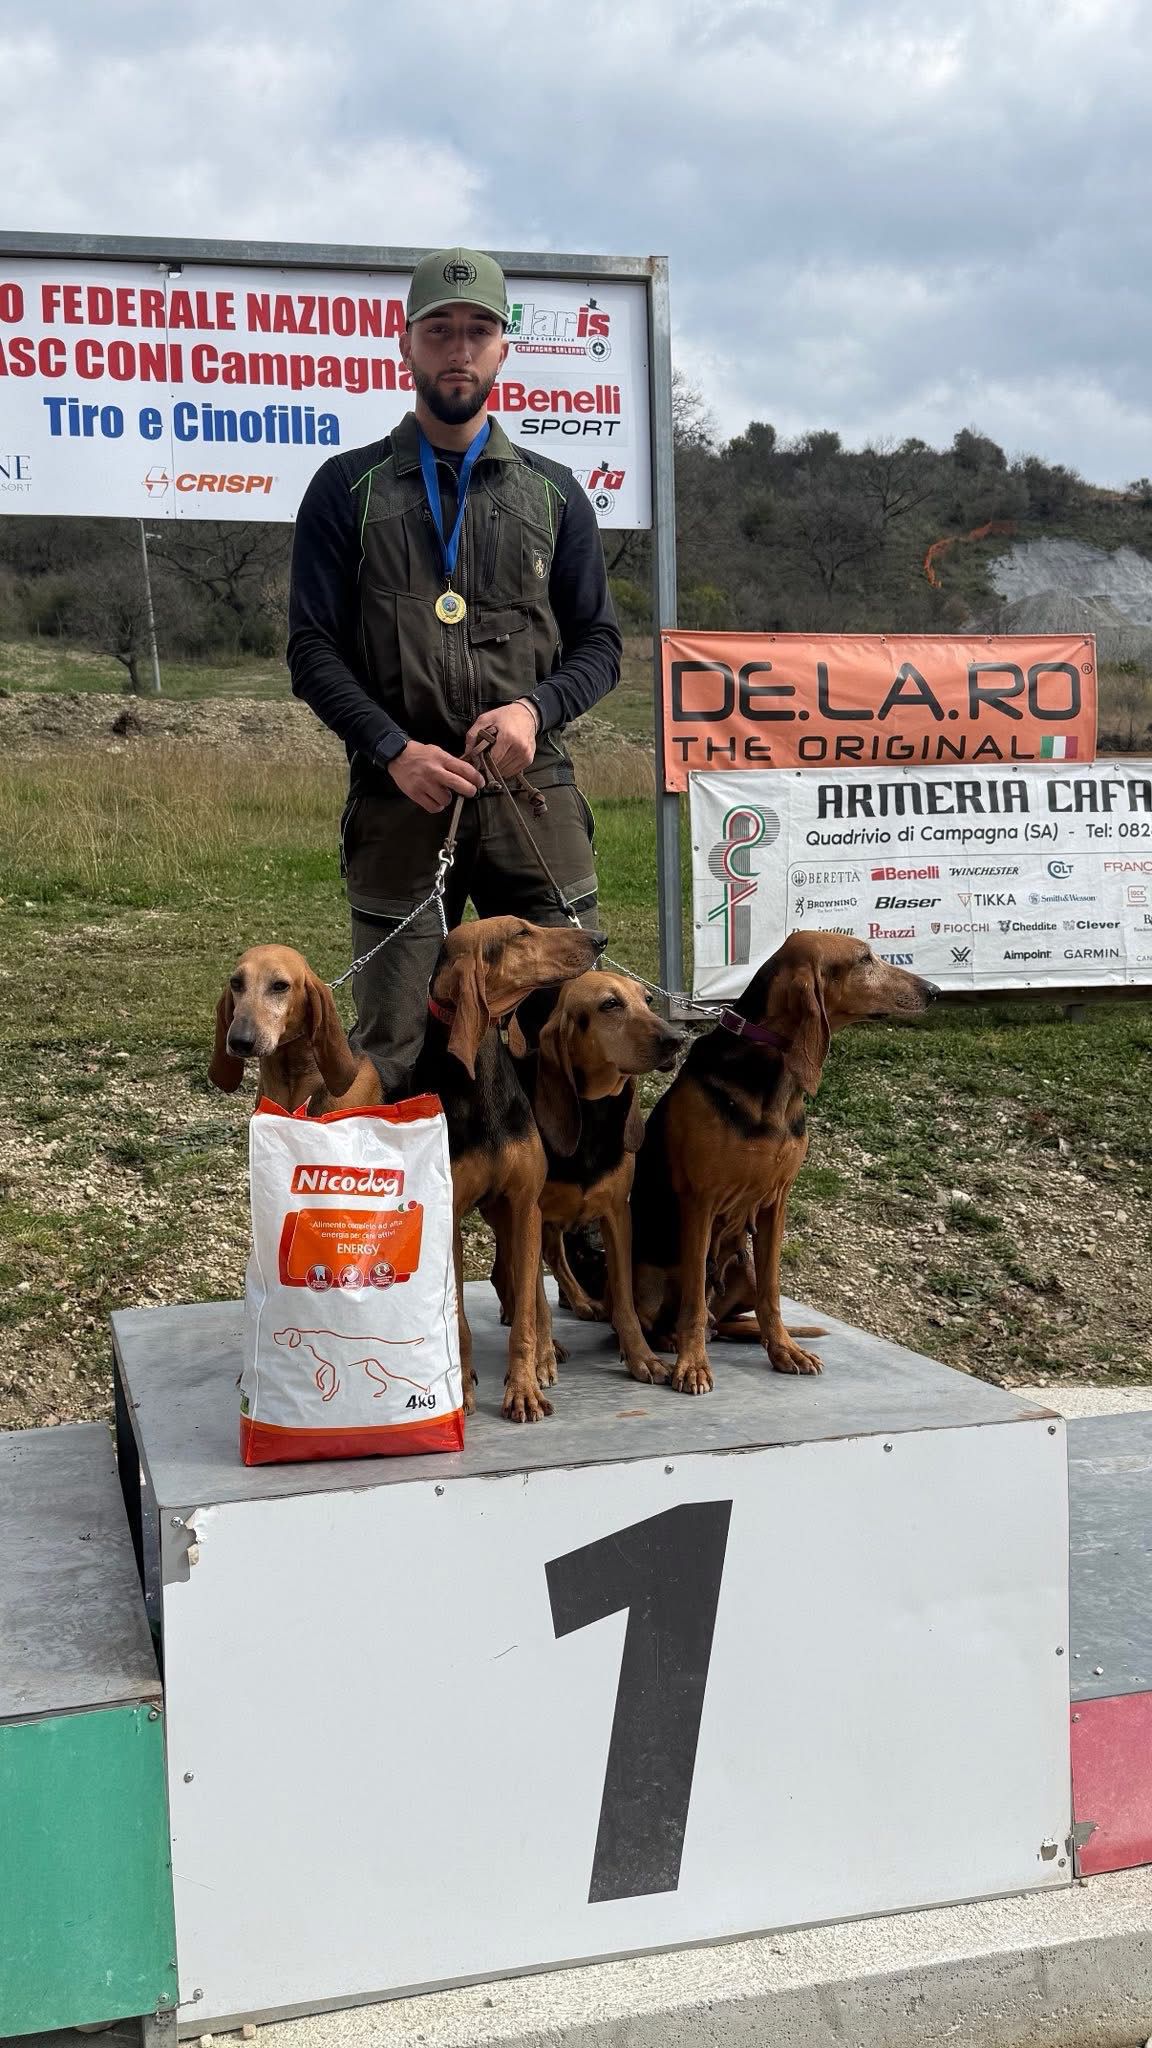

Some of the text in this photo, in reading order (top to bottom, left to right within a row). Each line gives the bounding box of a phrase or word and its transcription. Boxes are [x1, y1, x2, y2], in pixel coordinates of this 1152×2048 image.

[41, 285, 236, 331] FEDERALE
[75, 338, 183, 383] CONI
[502, 382, 621, 414] Benelli
[43, 397, 340, 445] Tiro e Cinofilia
[520, 419, 621, 437] SPORT
[175, 473, 273, 494] CRISPI
[672, 735, 1035, 762] THE ORIGINAL
[816, 780, 1152, 819] ARMERIA CAFA
[806, 828, 891, 846] Quadrivio
[897, 826, 914, 841] di
[920, 825, 1018, 845] Campagna
[1024, 823, 1058, 841] (SA)
[1086, 823, 1112, 838] Tel:
[1118, 823, 1152, 838] 082
[808, 871, 861, 884] BERETTA
[885, 866, 940, 881] Benelli
[949, 867, 1020, 877] WINCHESTER
[1047, 861, 1074, 879] COLT
[807, 898, 858, 909] BROWNING
[875, 896, 942, 910] Blaser
[974, 894, 1017, 906] TIKKA
[1041, 894, 1097, 903] Smith&Wesson
[867, 923, 916, 939] Perazzi
[943, 923, 990, 934] FIOCCHI
[1012, 922, 1057, 932] Cheddite
[1076, 920, 1121, 930] Clever
[1003, 949, 1052, 962] Aimpoint
[1063, 948, 1119, 960] GARMIN
[297, 1167, 399, 1197] Nicodog
[312, 1221, 346, 1229] Alimento
[347, 1222, 377, 1231] completo
[321, 1231, 349, 1240] energia
[350, 1231, 361, 1240] per
[336, 1243, 380, 1256] ENERGY
[405, 1393, 437, 1410] 4kg
[544, 1499, 734, 1904] 1
